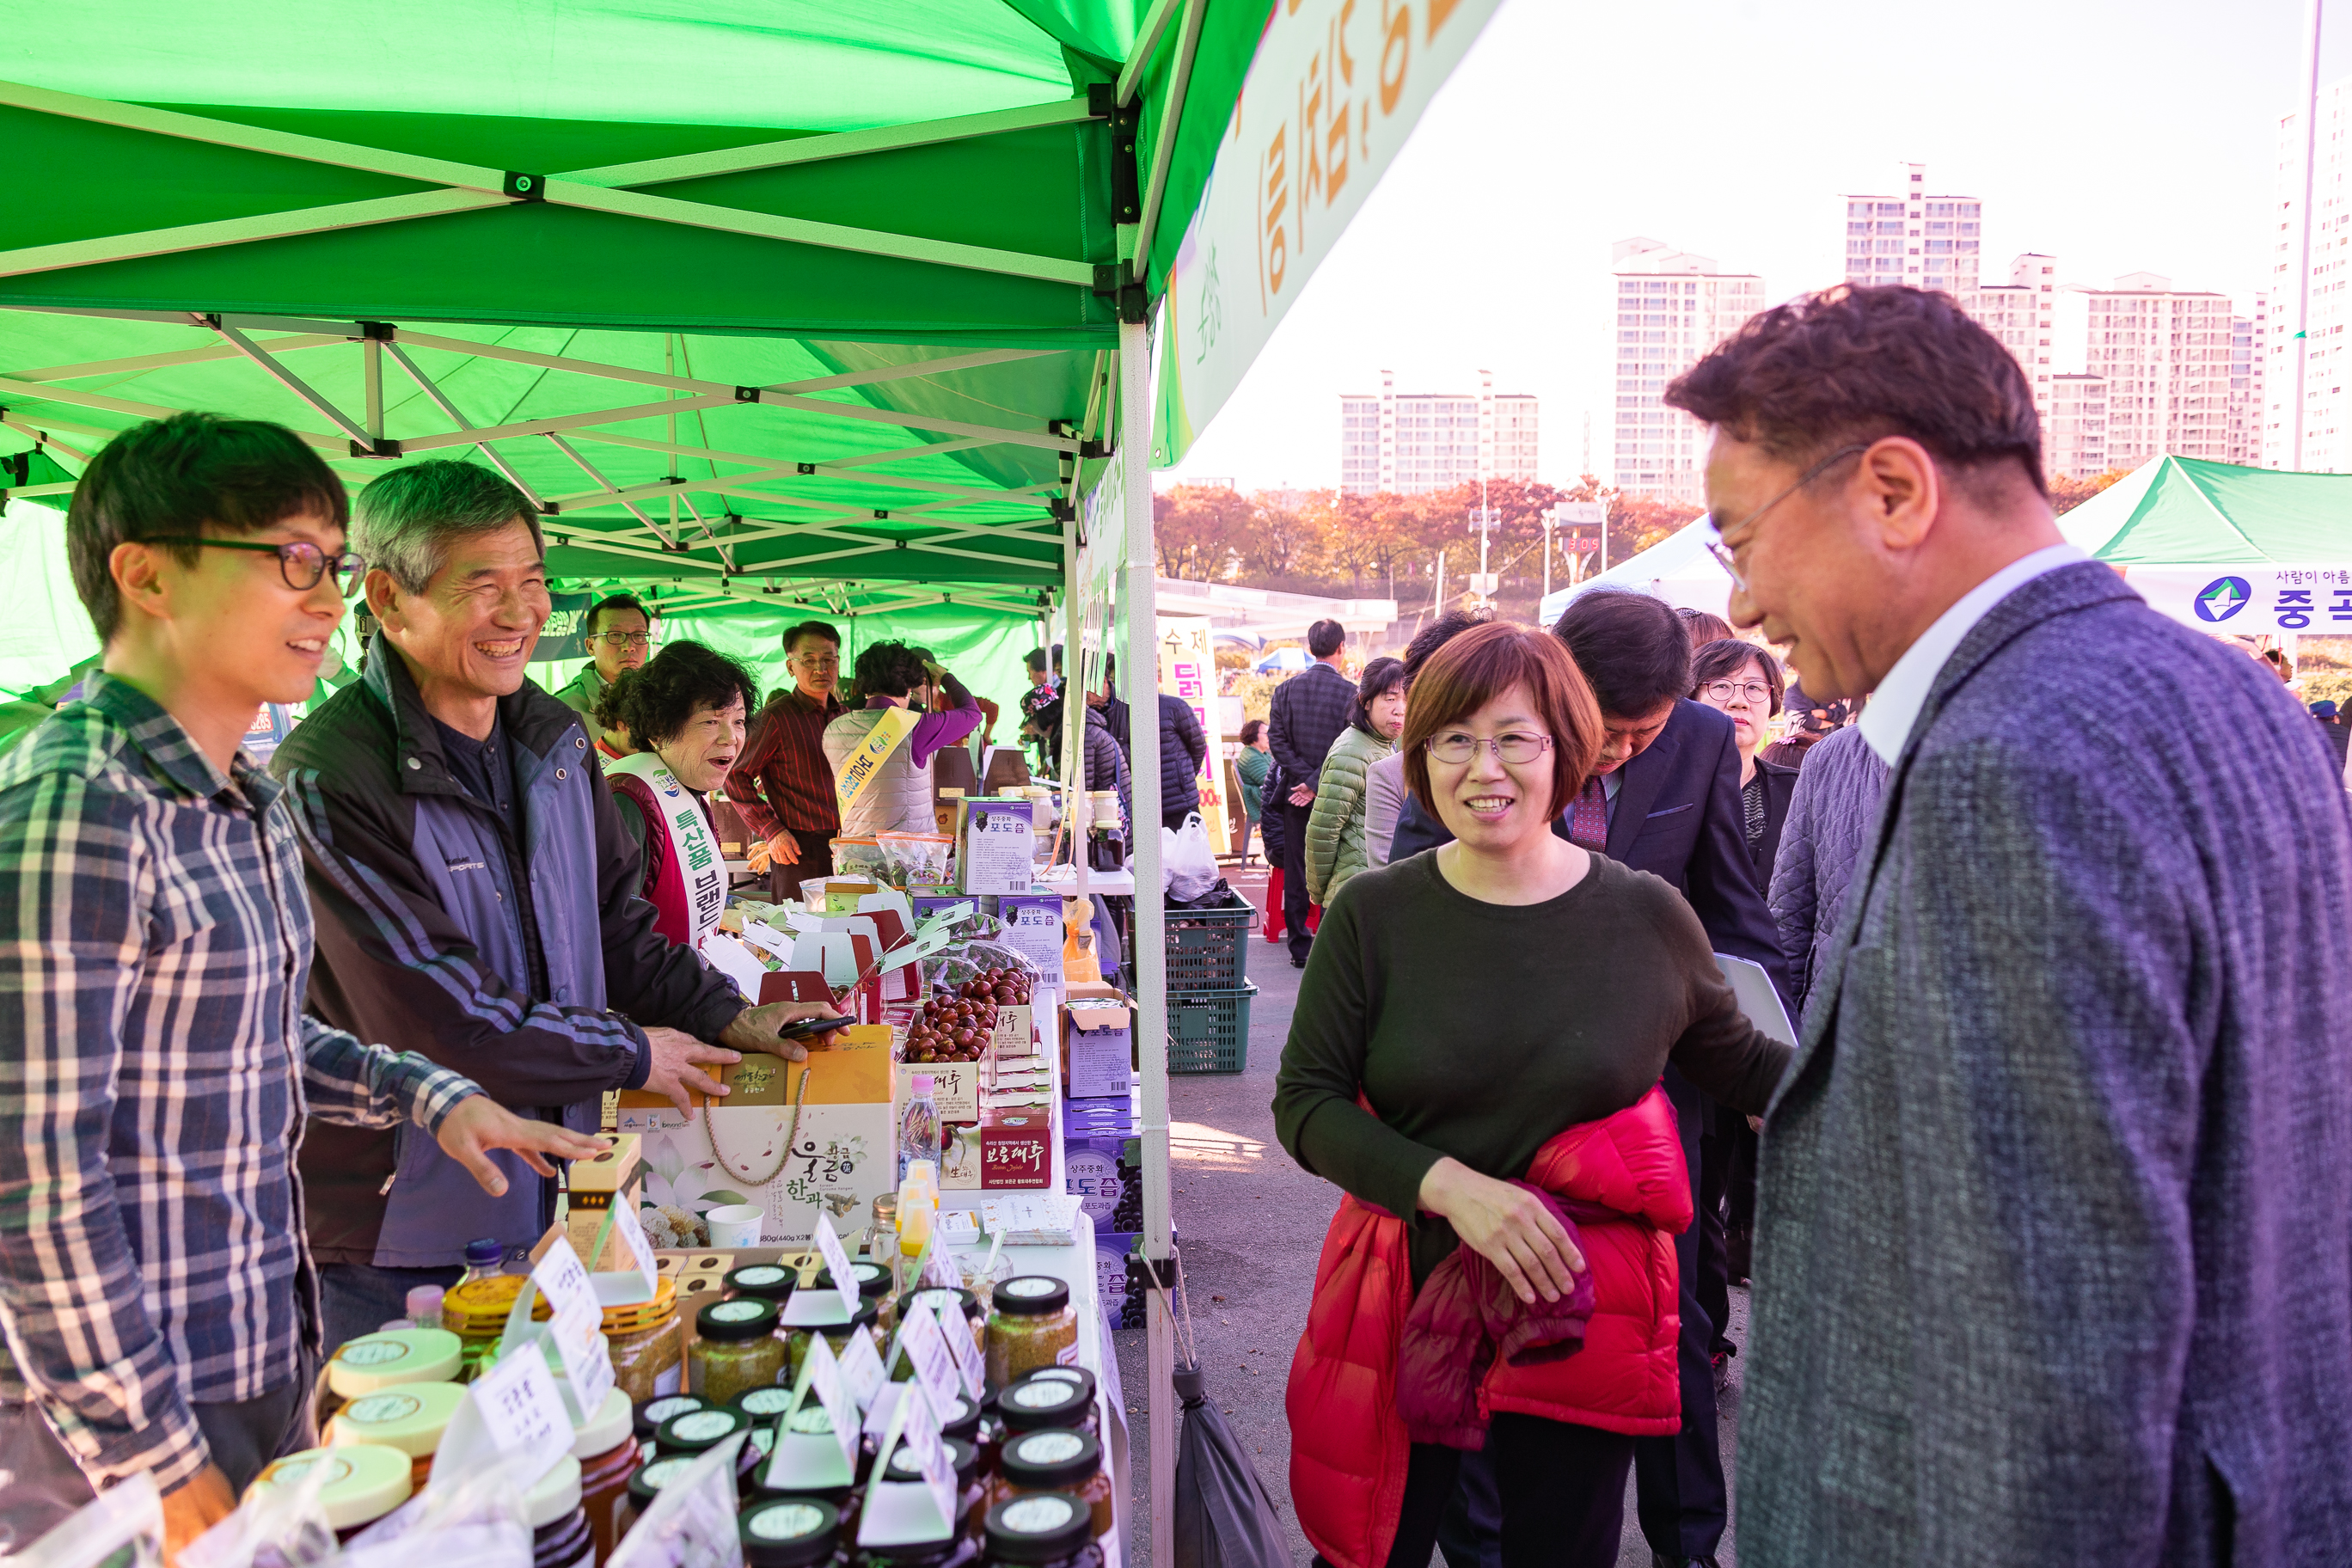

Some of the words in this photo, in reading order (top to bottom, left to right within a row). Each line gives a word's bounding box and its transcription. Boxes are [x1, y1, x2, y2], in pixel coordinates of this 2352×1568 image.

[2276, 570, 2318, 585] 사람이
[2323, 570, 2350, 585] 아름
[1165, 628, 1208, 655] 수제
[990, 823, 1025, 834] 포도즙
[675, 808, 713, 872] 특산품
[694, 869, 720, 932] 브랜드
[1020, 916, 1055, 926] 포도즙
[986, 1140, 1044, 1172] 보은대추
[1070, 1164, 1104, 1173] 상주중화
[787, 1178, 823, 1210] 한과
